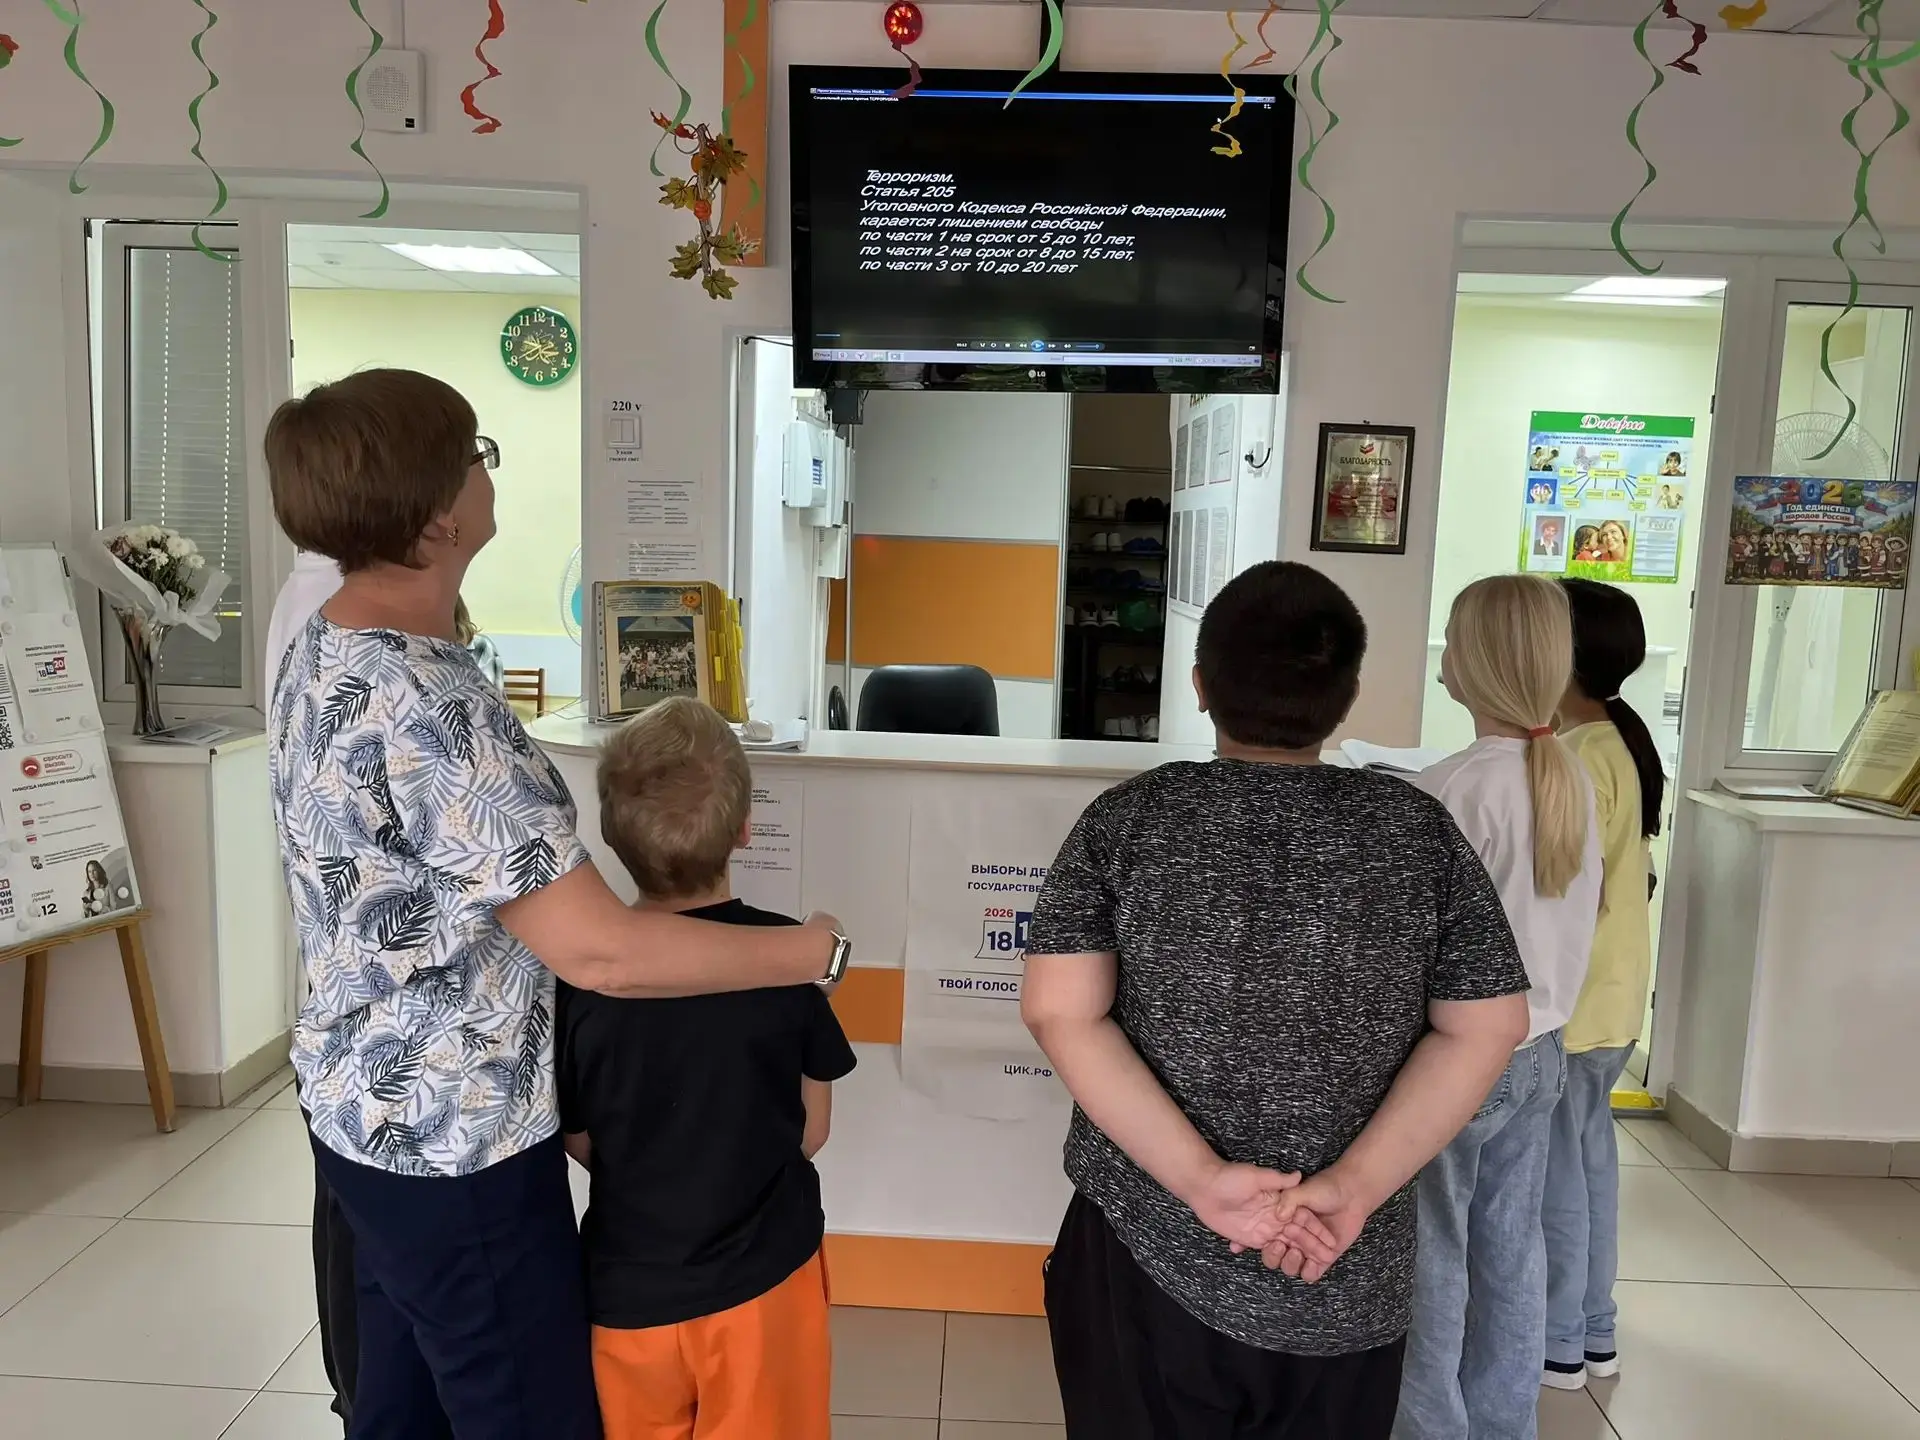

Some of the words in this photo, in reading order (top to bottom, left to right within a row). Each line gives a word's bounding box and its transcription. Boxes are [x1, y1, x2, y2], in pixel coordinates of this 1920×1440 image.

[866, 169, 954, 184] Терроризм.
[860, 184, 920, 197] Статья
[921, 186, 957, 198] 205
[859, 199, 954, 213] Уголовного
[957, 201, 1027, 214] Кодекса
[1029, 202, 1128, 216] Российской
[1131, 204, 1227, 219] Федерации,
[859, 216, 936, 228] карается
[937, 217, 1028, 229] лишением
[1031, 217, 1104, 232] свободы
[859, 230, 881, 241] по
[885, 232, 933, 242] части
[939, 230, 948, 242] 1
[950, 233, 972, 243] на
[975, 233, 1015, 246] срок
[1016, 234, 1037, 244] от
[1039, 232, 1053, 244] 5
[1051, 235, 1076, 246] до
[1082, 233, 1103, 245] 10
[1103, 236, 1135, 247] лет,
[859, 245, 881, 256] по
[885, 246, 932, 256] части
[935, 245, 949, 256] 2
[950, 247, 972, 257] на
[975, 247, 1014, 260] срок
[1016, 248, 1037, 258] от
[1039, 247, 1053, 259] 8
[1051, 250, 1076, 261] до
[1082, 247, 1103, 259] 15
[1102, 250, 1135, 261] лет,
[859, 260, 882, 270] по
[885, 261, 933, 271] части
[935, 260, 949, 271] 3
[950, 262, 971, 272] от
[976, 260, 996, 272] 10
[994, 262, 1019, 274] до
[1021, 261, 1045, 273] 20
[1046, 263, 1078, 274] лет
[519, 315, 530, 326] 11
[533, 311, 546, 323] 12
[550, 316, 556, 327] 1
[508, 325, 521, 337] 10
[560, 327, 568, 339] 2
[505, 340, 513, 352] 9
[564, 341, 572, 353] 3
[510, 354, 518, 367] 8
[561, 357, 568, 368] 4
[522, 367, 529, 378] 7
[535, 370, 543, 382] 6
[550, 367, 558, 378] 5
[1036, 370, 1046, 378] LG
[612, 400, 632, 412] 220
[1580, 414, 1645, 433] Доверие
[1339, 456, 1392, 466] БЛАГОДАРНОСТЬ
[1786, 503, 1803, 512] Год
[1805, 504, 1851, 513] единства
[1785, 512, 1820, 521] народов
[1822, 513, 1850, 521] России
[46, 664, 54, 673] 19
[53, 659, 64, 669] 20
[38, 669, 47, 678] 18
[971, 863, 1027, 877] ВЫБОРЫ
[984, 907, 1014, 918] 2026
[987, 930, 1012, 952] 18
[938, 977, 973, 990] ТВОЙ
[975, 980, 1018, 993] ГОЛОС
[1004, 1064, 1053, 1078] ЦИК.РФ
